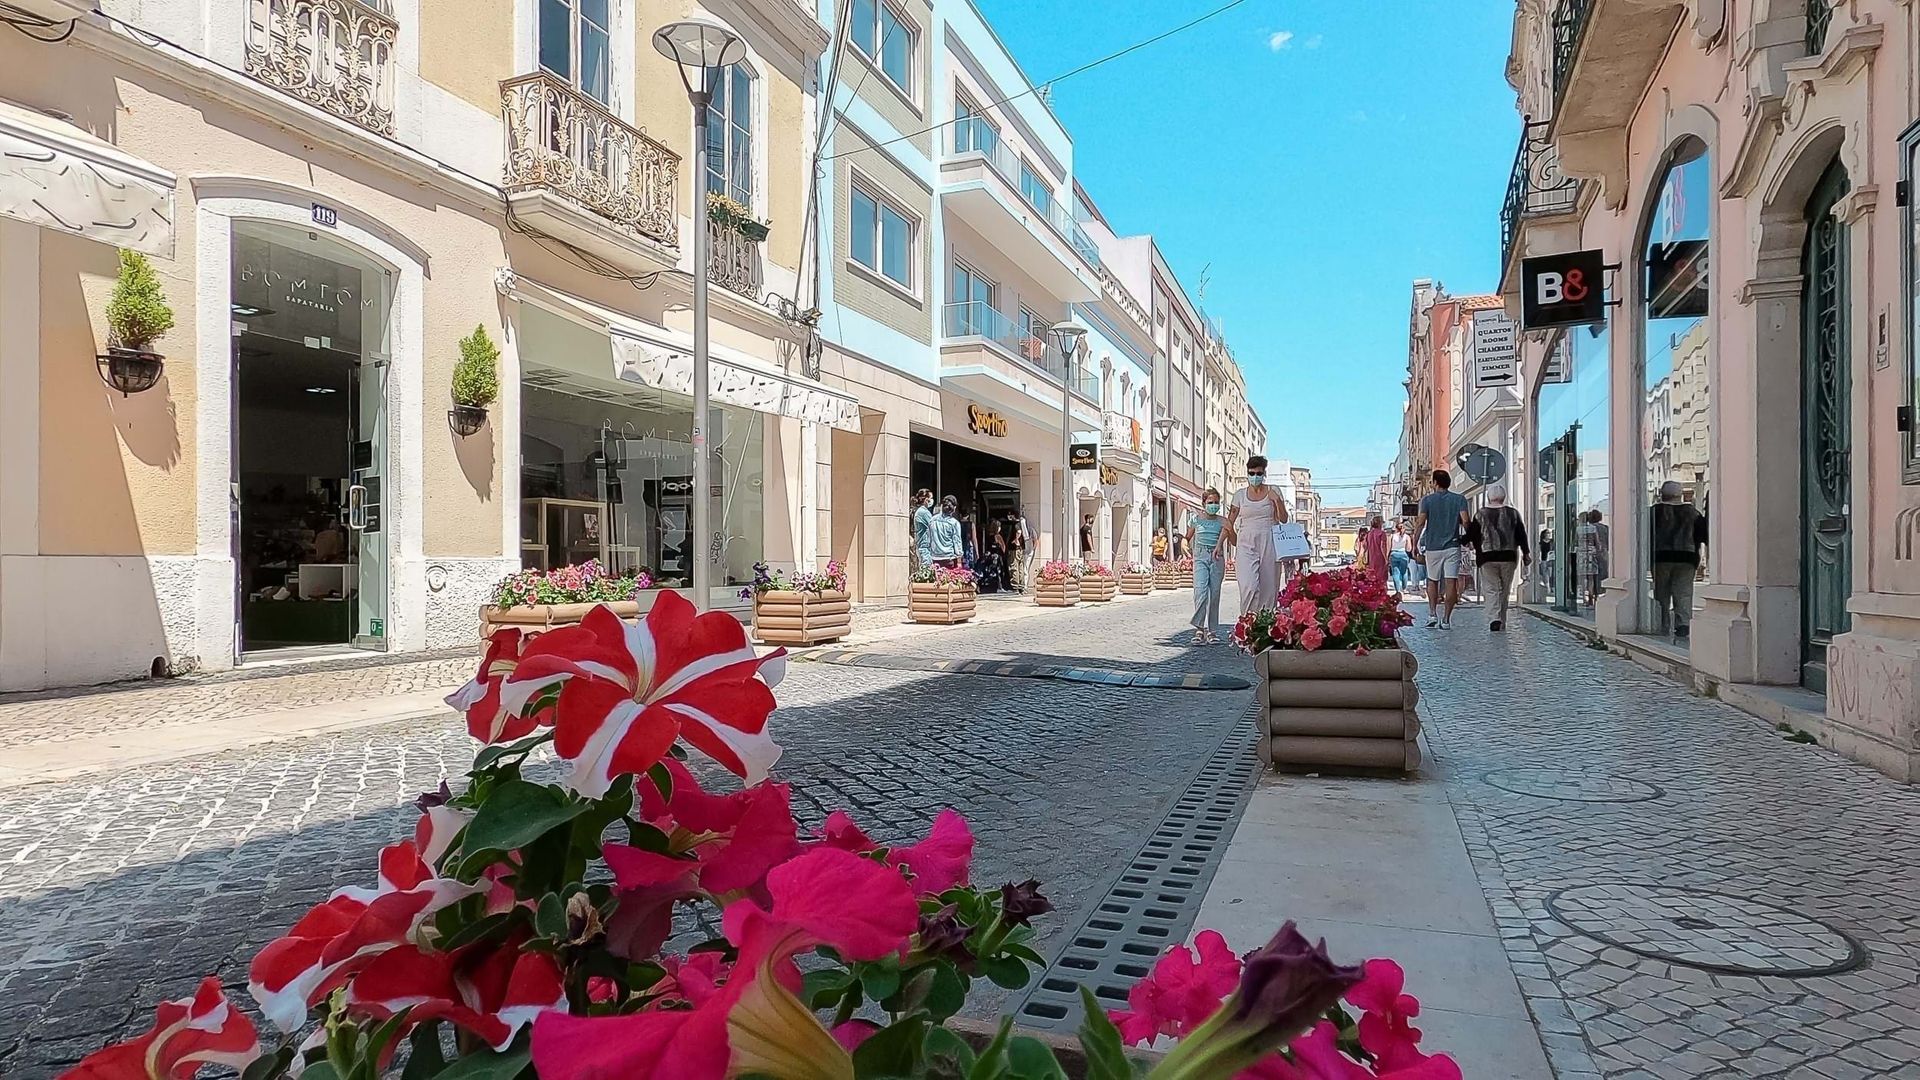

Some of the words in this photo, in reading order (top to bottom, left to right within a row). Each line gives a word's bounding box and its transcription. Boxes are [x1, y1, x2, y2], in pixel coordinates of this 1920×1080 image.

[316, 206, 335, 224] 119
[1537, 268, 1590, 305] B&
[285, 295, 335, 312] SAPATARIA
[1478, 328, 1512, 336] QUARTOS
[1482, 336, 1508, 344] ROOMS
[1477, 345, 1514, 353] CHAMBRES
[968, 404, 1009, 438] Sportino
